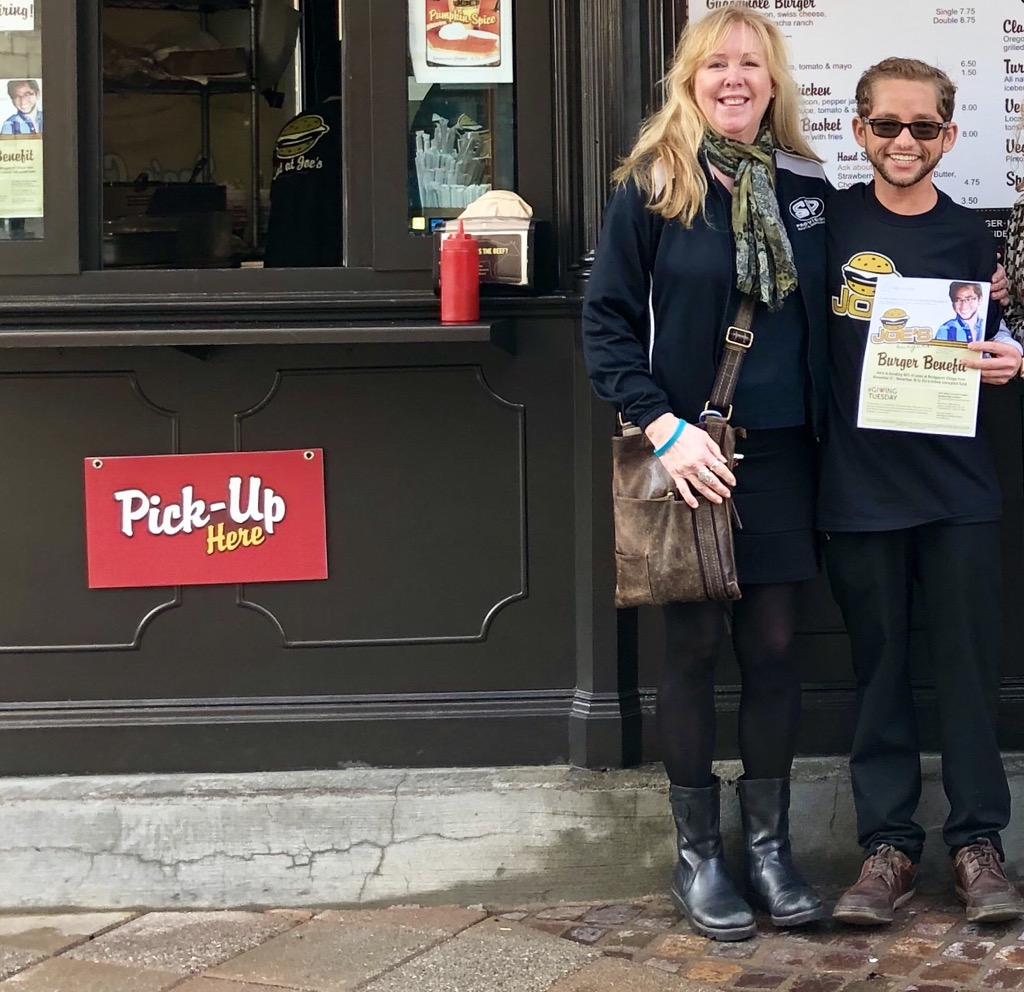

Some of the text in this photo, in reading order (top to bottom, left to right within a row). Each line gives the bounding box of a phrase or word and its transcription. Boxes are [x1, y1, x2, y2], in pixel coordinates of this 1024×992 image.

[429, 8, 497, 26] Pumpkin Spice
[801, 118, 842, 132] Basket
[285, 156, 323, 171] at Joe's
[837, 152, 858, 162] Hand
[871, 327, 933, 344] JOE'S
[877, 352, 919, 370] Burger
[868, 393, 898, 401] TUESDAY
[113, 476, 286, 536] Pick-Up
[206, 522, 265, 554] Here
